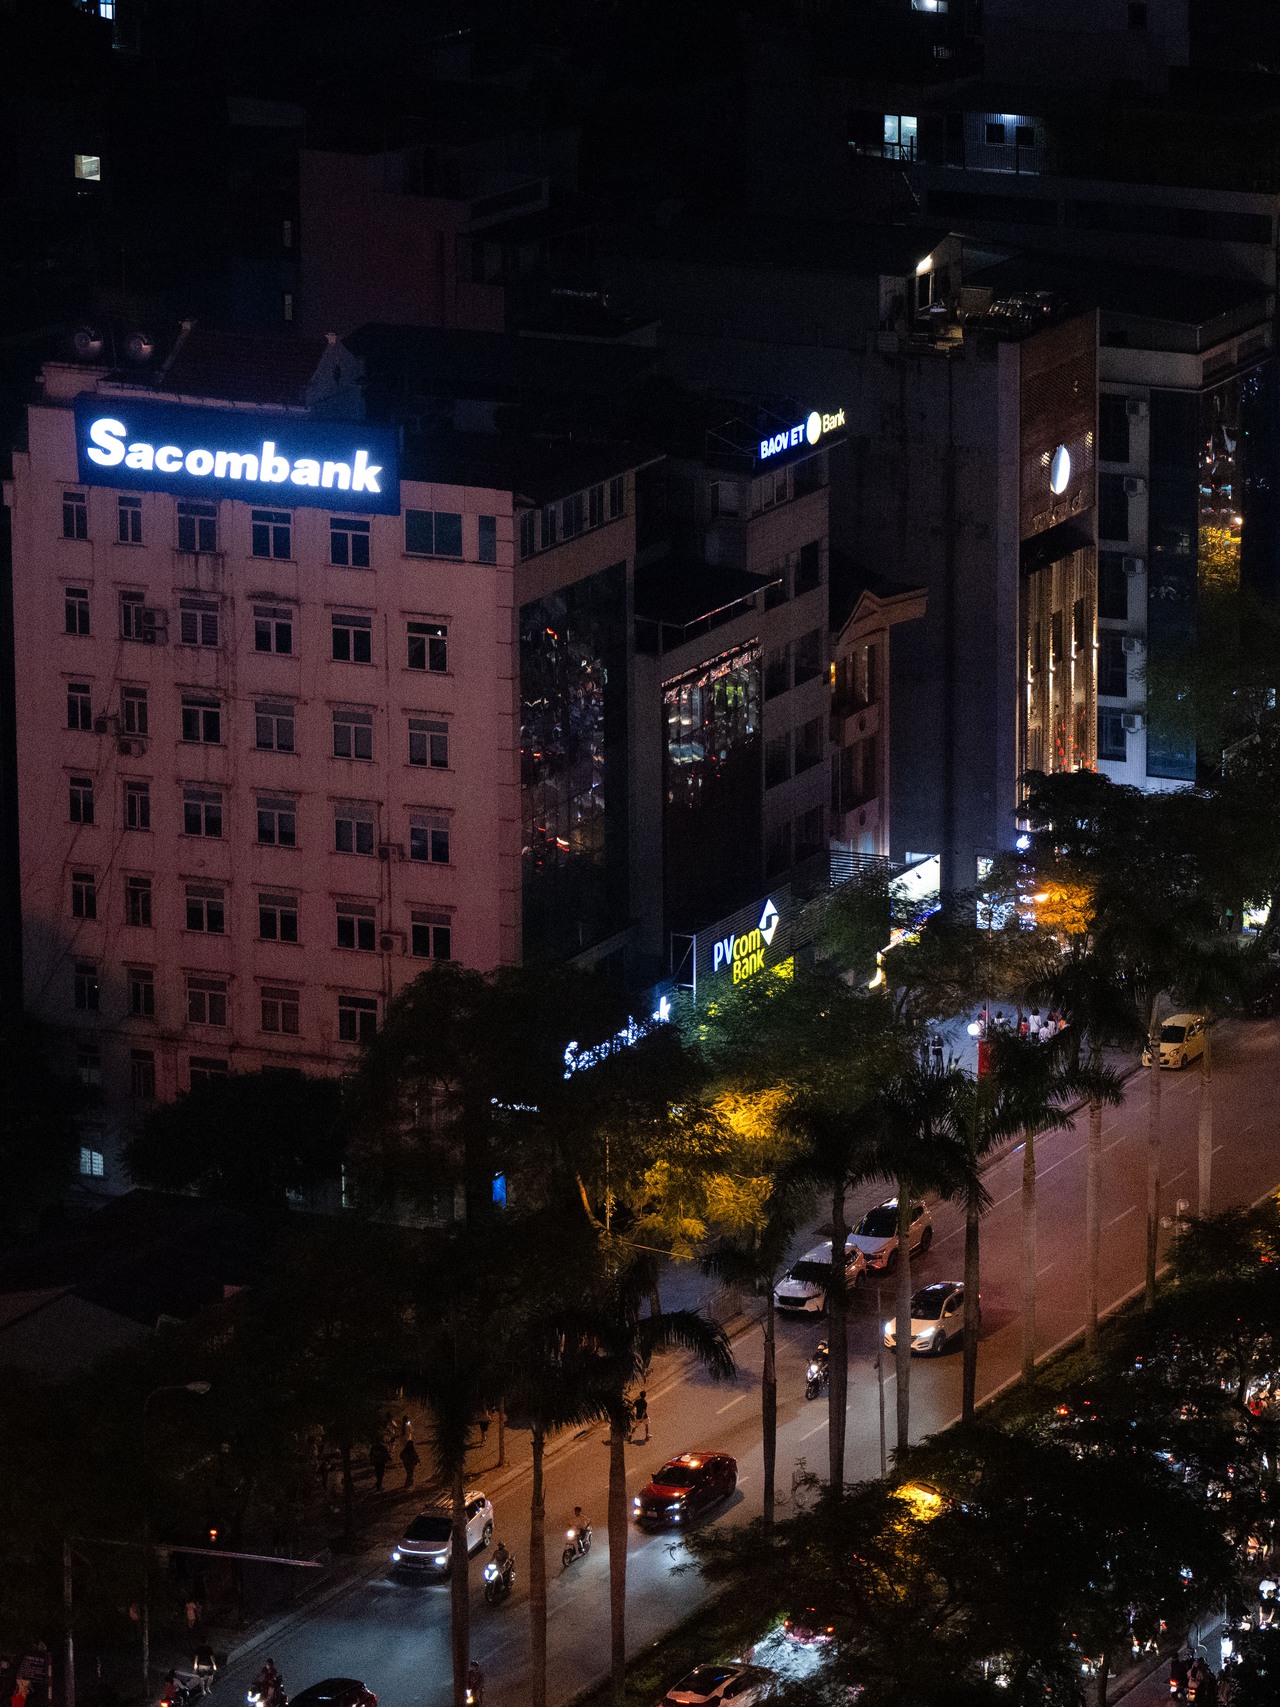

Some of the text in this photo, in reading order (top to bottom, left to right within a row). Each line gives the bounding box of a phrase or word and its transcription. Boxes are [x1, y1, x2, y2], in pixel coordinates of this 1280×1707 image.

[86, 418, 383, 493] Sacombank
[760, 407, 846, 460] BAOVET Bank
[713, 927, 761, 972] PVcom
[733, 947, 766, 985] Bank
